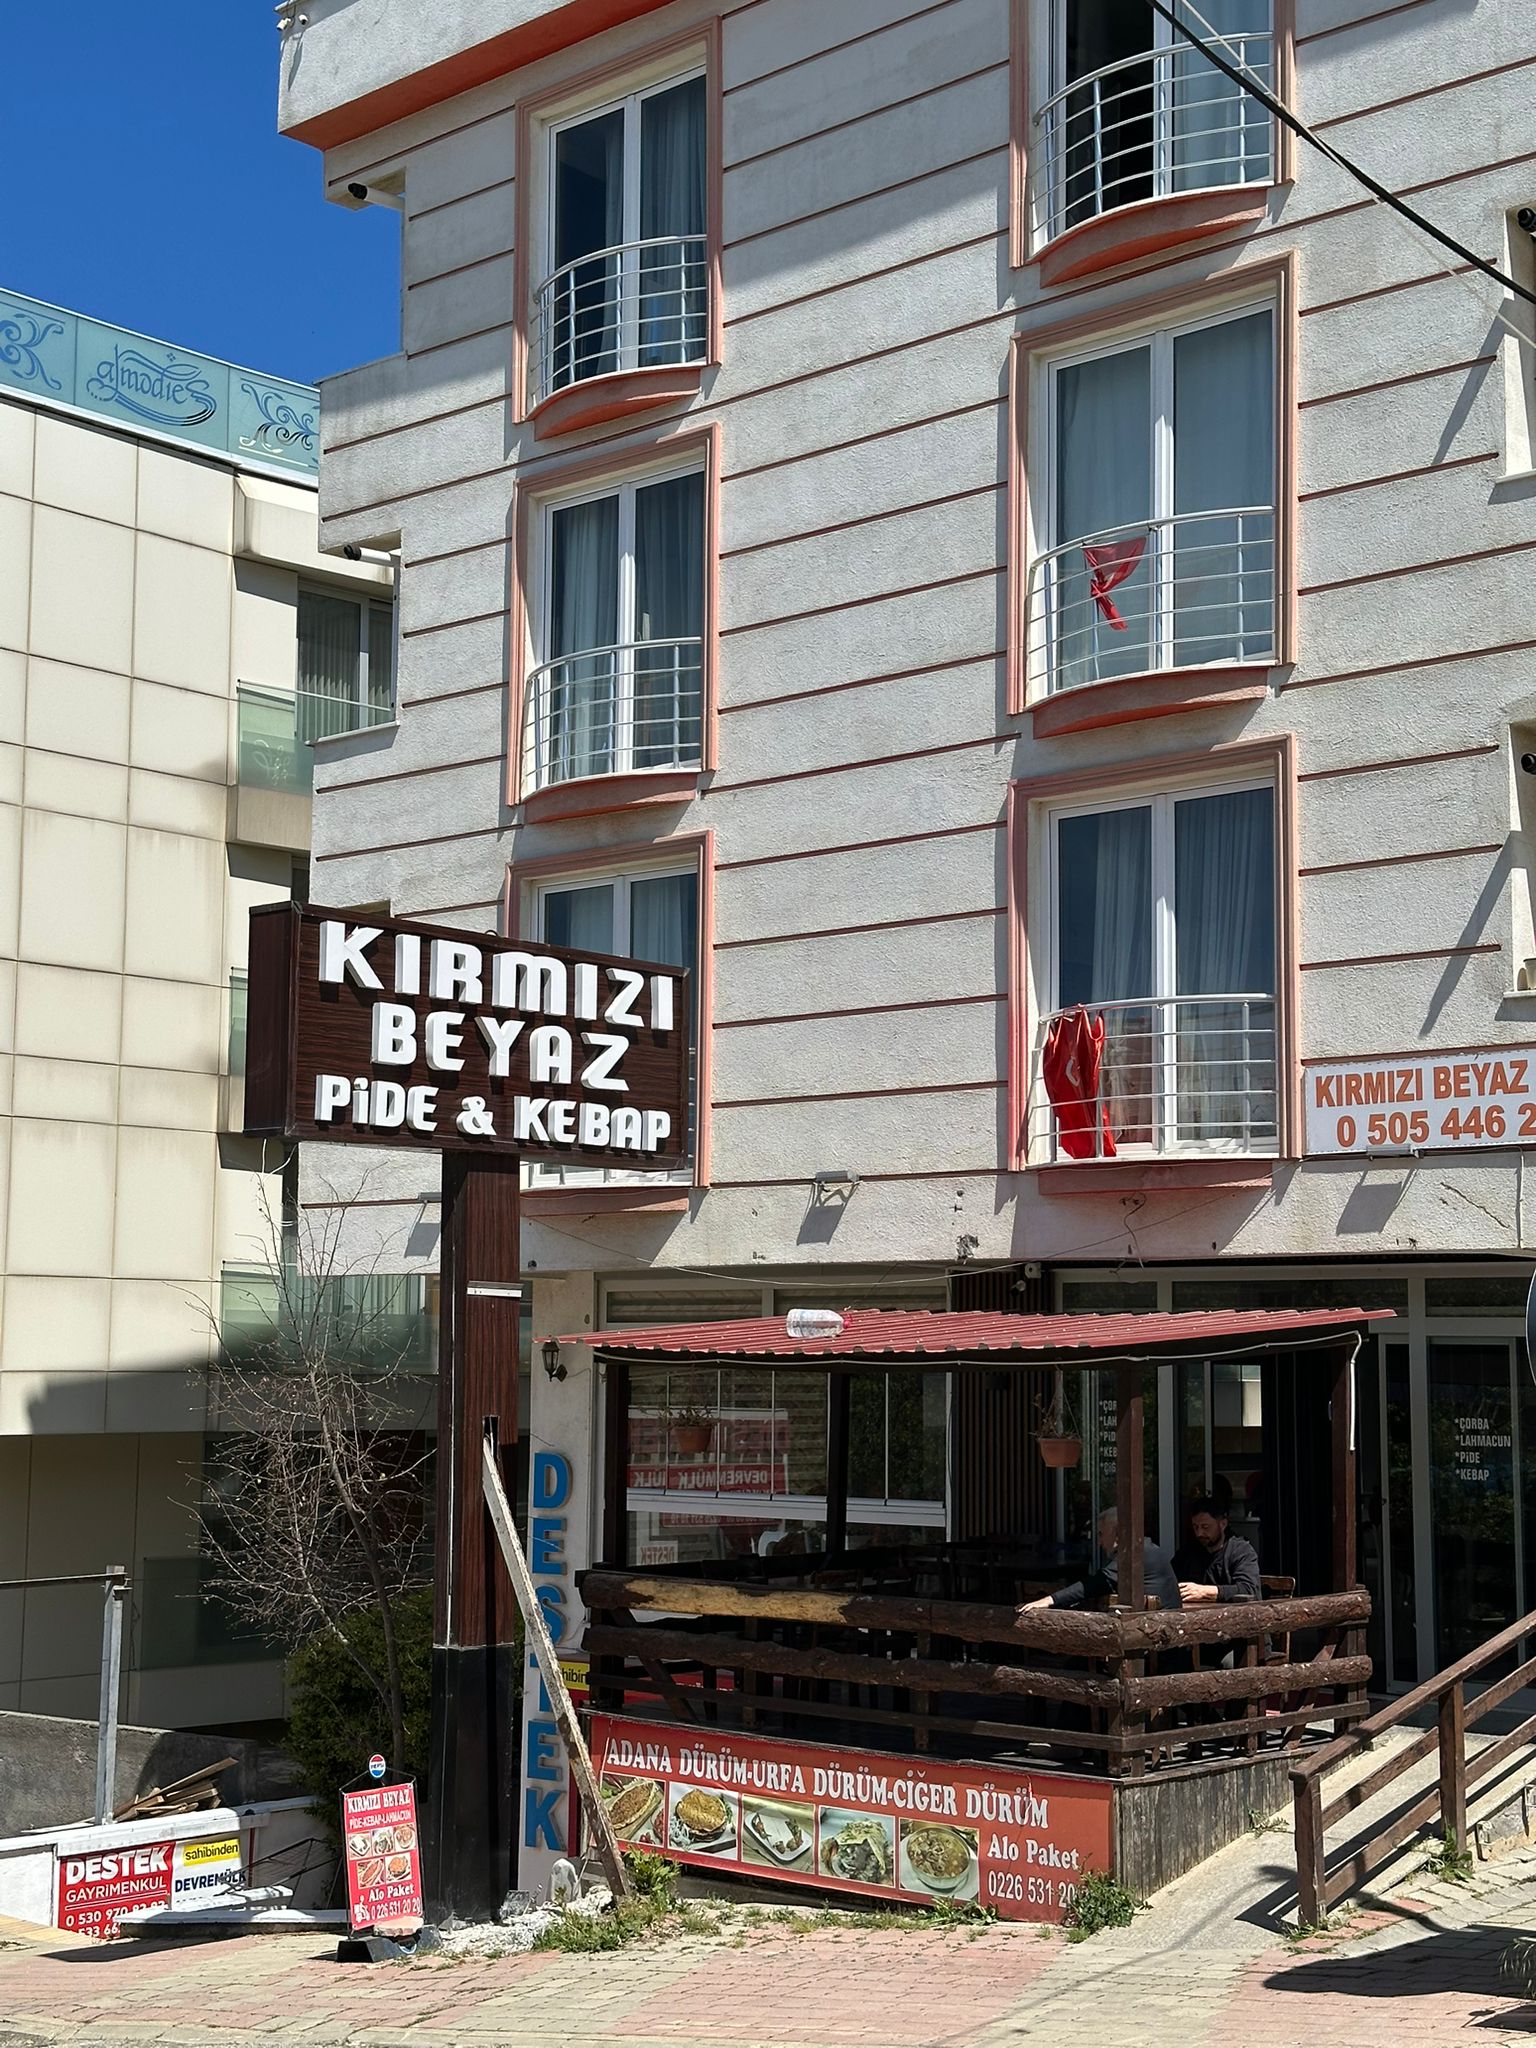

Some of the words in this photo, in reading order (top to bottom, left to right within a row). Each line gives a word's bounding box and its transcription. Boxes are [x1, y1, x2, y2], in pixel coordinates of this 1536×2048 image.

[318, 920, 674, 1031] KIRMIZI
[370, 1001, 630, 1092] BEYAZ
[1315, 1068, 1423, 1108] KIRMIZI
[1433, 1059, 1530, 1100] BEYAZ
[455, 1096, 497, 1136] &
[513, 1095, 671, 1152] KEBAP
[1336, 1115, 1357, 1147] 0
[1367, 1110, 1430, 1146] 505
[1440, 1104, 1507, 1140] 446
[1459, 1417, 1490, 1432] ÇORBA
[1460, 1435, 1511, 1448] LAHMACUN
[1460, 1468, 1490, 1481] KEBAP
[347, 1793, 381, 1813] KIRMIZI
[382, 1789, 411, 1808] BEYAZ
[607, 1738, 673, 1774] ADANA
[965, 1782, 1049, 1829] DÜRÜM
[65, 1846, 170, 1885] DESTEK
[185, 1844, 239, 1861] sahibinden
[987, 1833, 1020, 1861] Alo
[1026, 1839, 1080, 1870] Paket
[369, 1888, 385, 1903] Alo
[387, 1883, 414, 1899] Paket
[988, 1870, 1023, 1901] 0226
[1027, 1876, 1054, 1906] 531
[66, 1915, 75, 1927] 0
[78, 1911, 102, 1925] 530
[104, 1921, 121, 1936] 66
